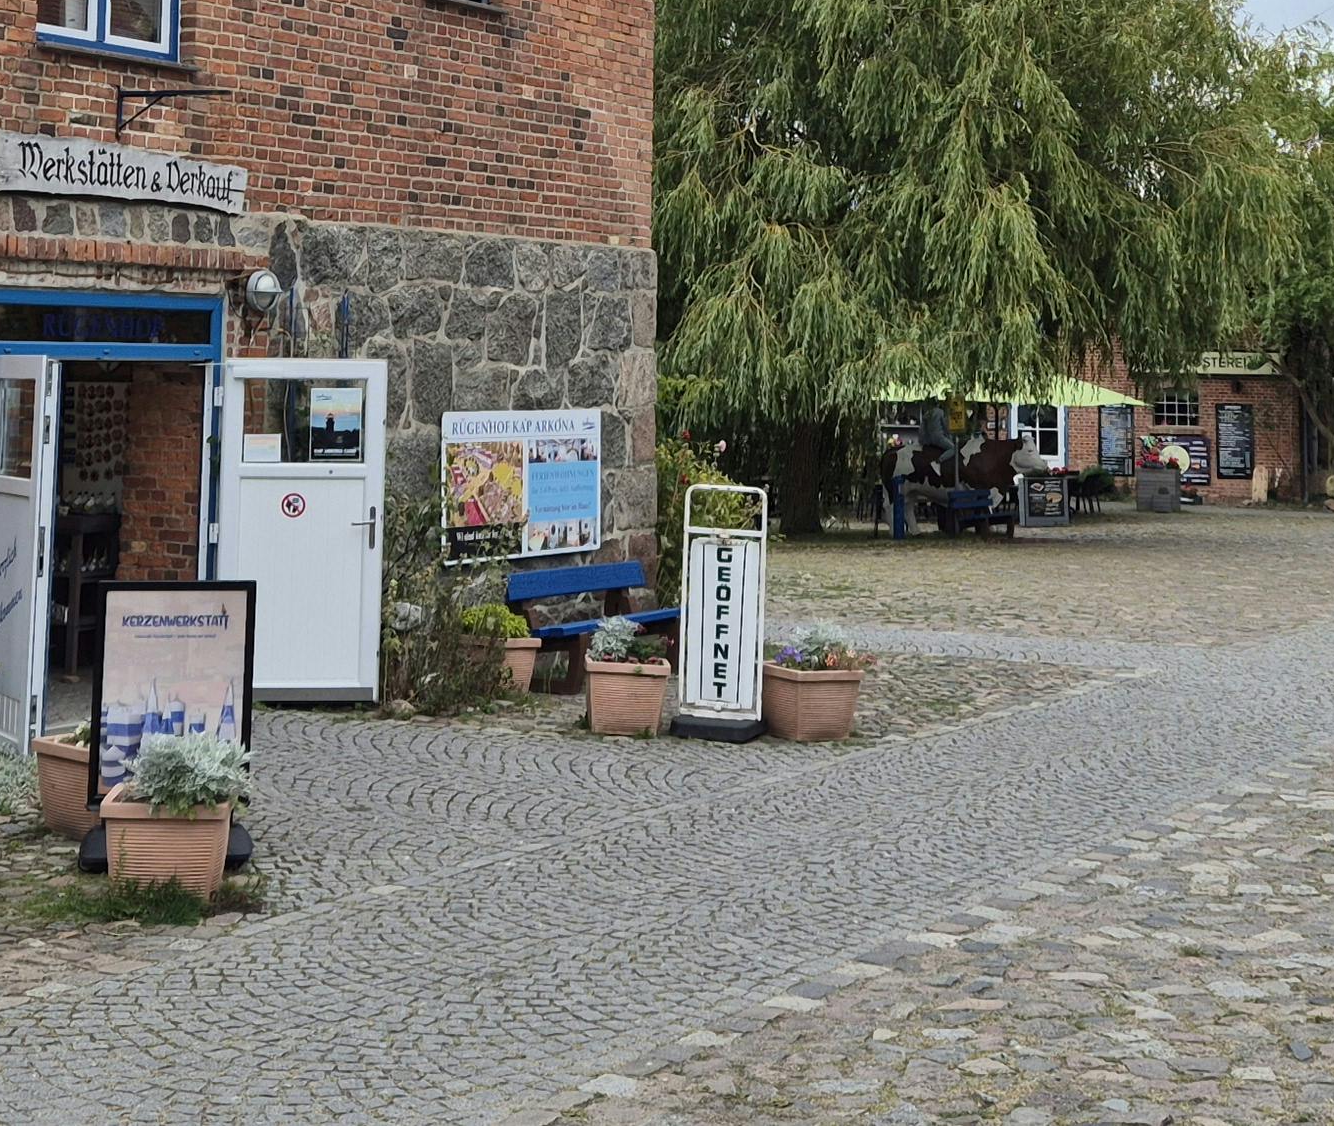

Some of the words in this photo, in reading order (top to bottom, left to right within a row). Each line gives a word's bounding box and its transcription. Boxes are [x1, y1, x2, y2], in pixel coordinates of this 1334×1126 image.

[150, 171, 163, 193] &
[452, 417, 510, 435] RÜGENHOF
[512, 418, 533, 434] KAP
[534, 417, 575, 433] ARKONA
[122, 613, 229, 631] KERZENWERKSTATT
[713, 547, 733, 698] GEÖFFNET
